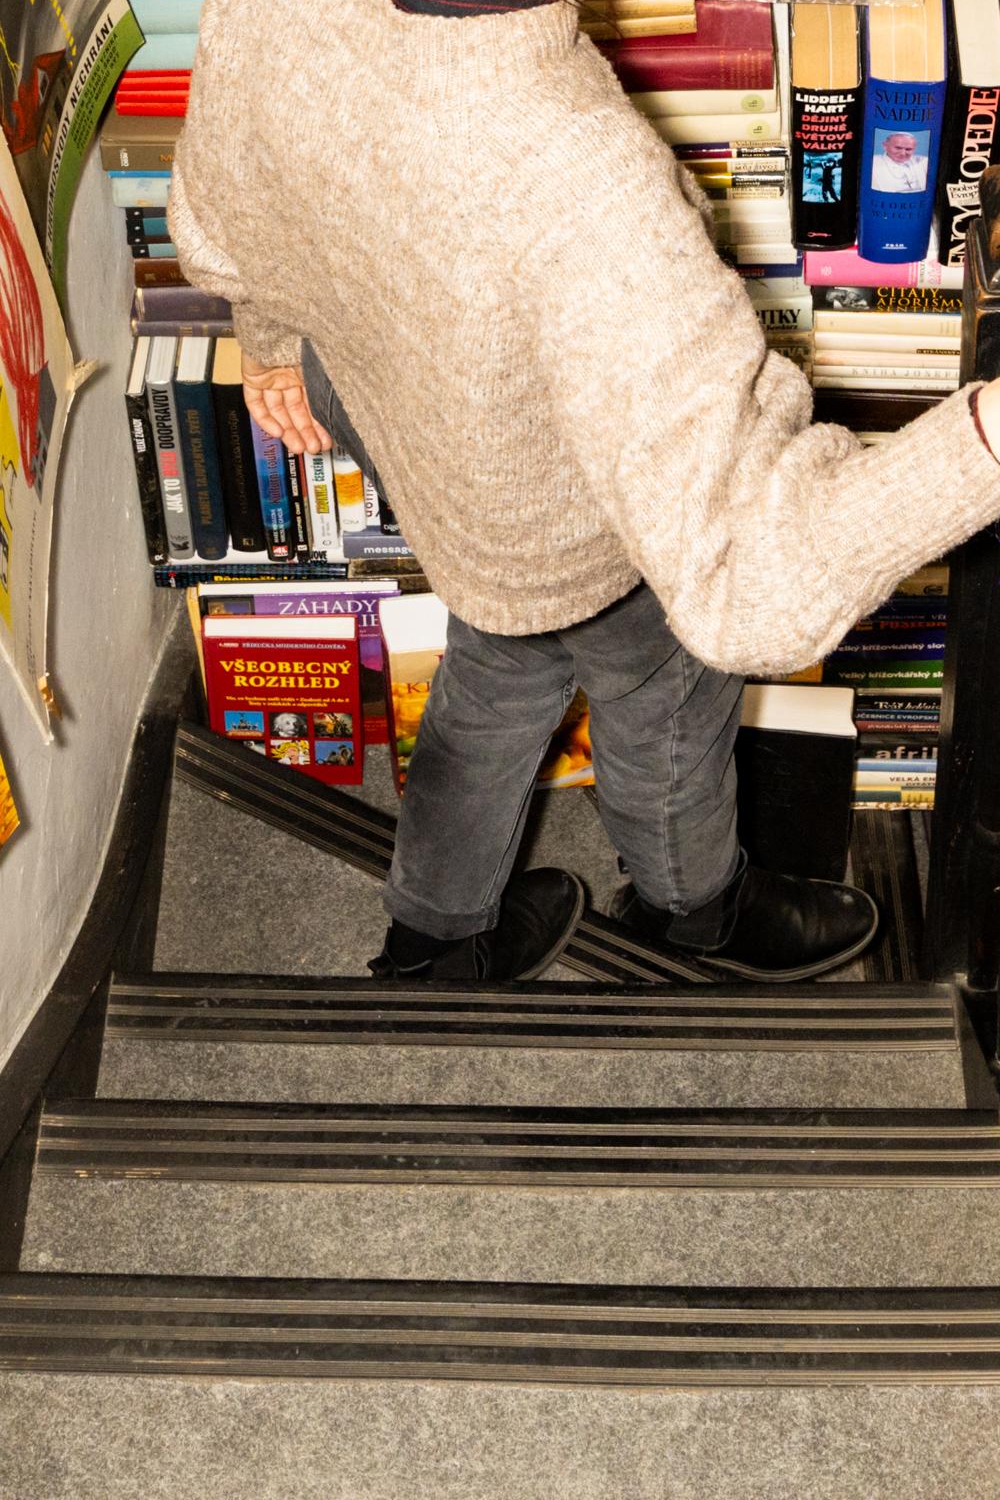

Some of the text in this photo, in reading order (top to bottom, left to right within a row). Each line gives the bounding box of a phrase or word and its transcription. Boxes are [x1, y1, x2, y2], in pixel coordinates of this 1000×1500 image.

[70, 12, 114, 108] NECHRÁNÍ
[794, 92, 856, 104] LIDDELL
[804, 103, 847, 114] HART
[801, 112, 849, 124] DĚJINY
[801, 121, 848, 132] DRUHÉ
[795, 130, 854, 142] SVĚTOVÉ
[801, 139, 847, 151] VÁLKY
[948, 87, 1000, 268] ENCYLOPEDIE
[876, 297, 964, 309] AFORISMY
[151, 388, 176, 450] DOOPRAVDY
[163, 478, 181, 494] TO
[167, 496, 183, 514] JAK
[278, 598, 377, 616] ZÁHADY
[218, 658, 352, 675] VŠEOBECNÝ
[233, 675, 341, 690] ROZHLED
[875, 746, 938, 760] afri
